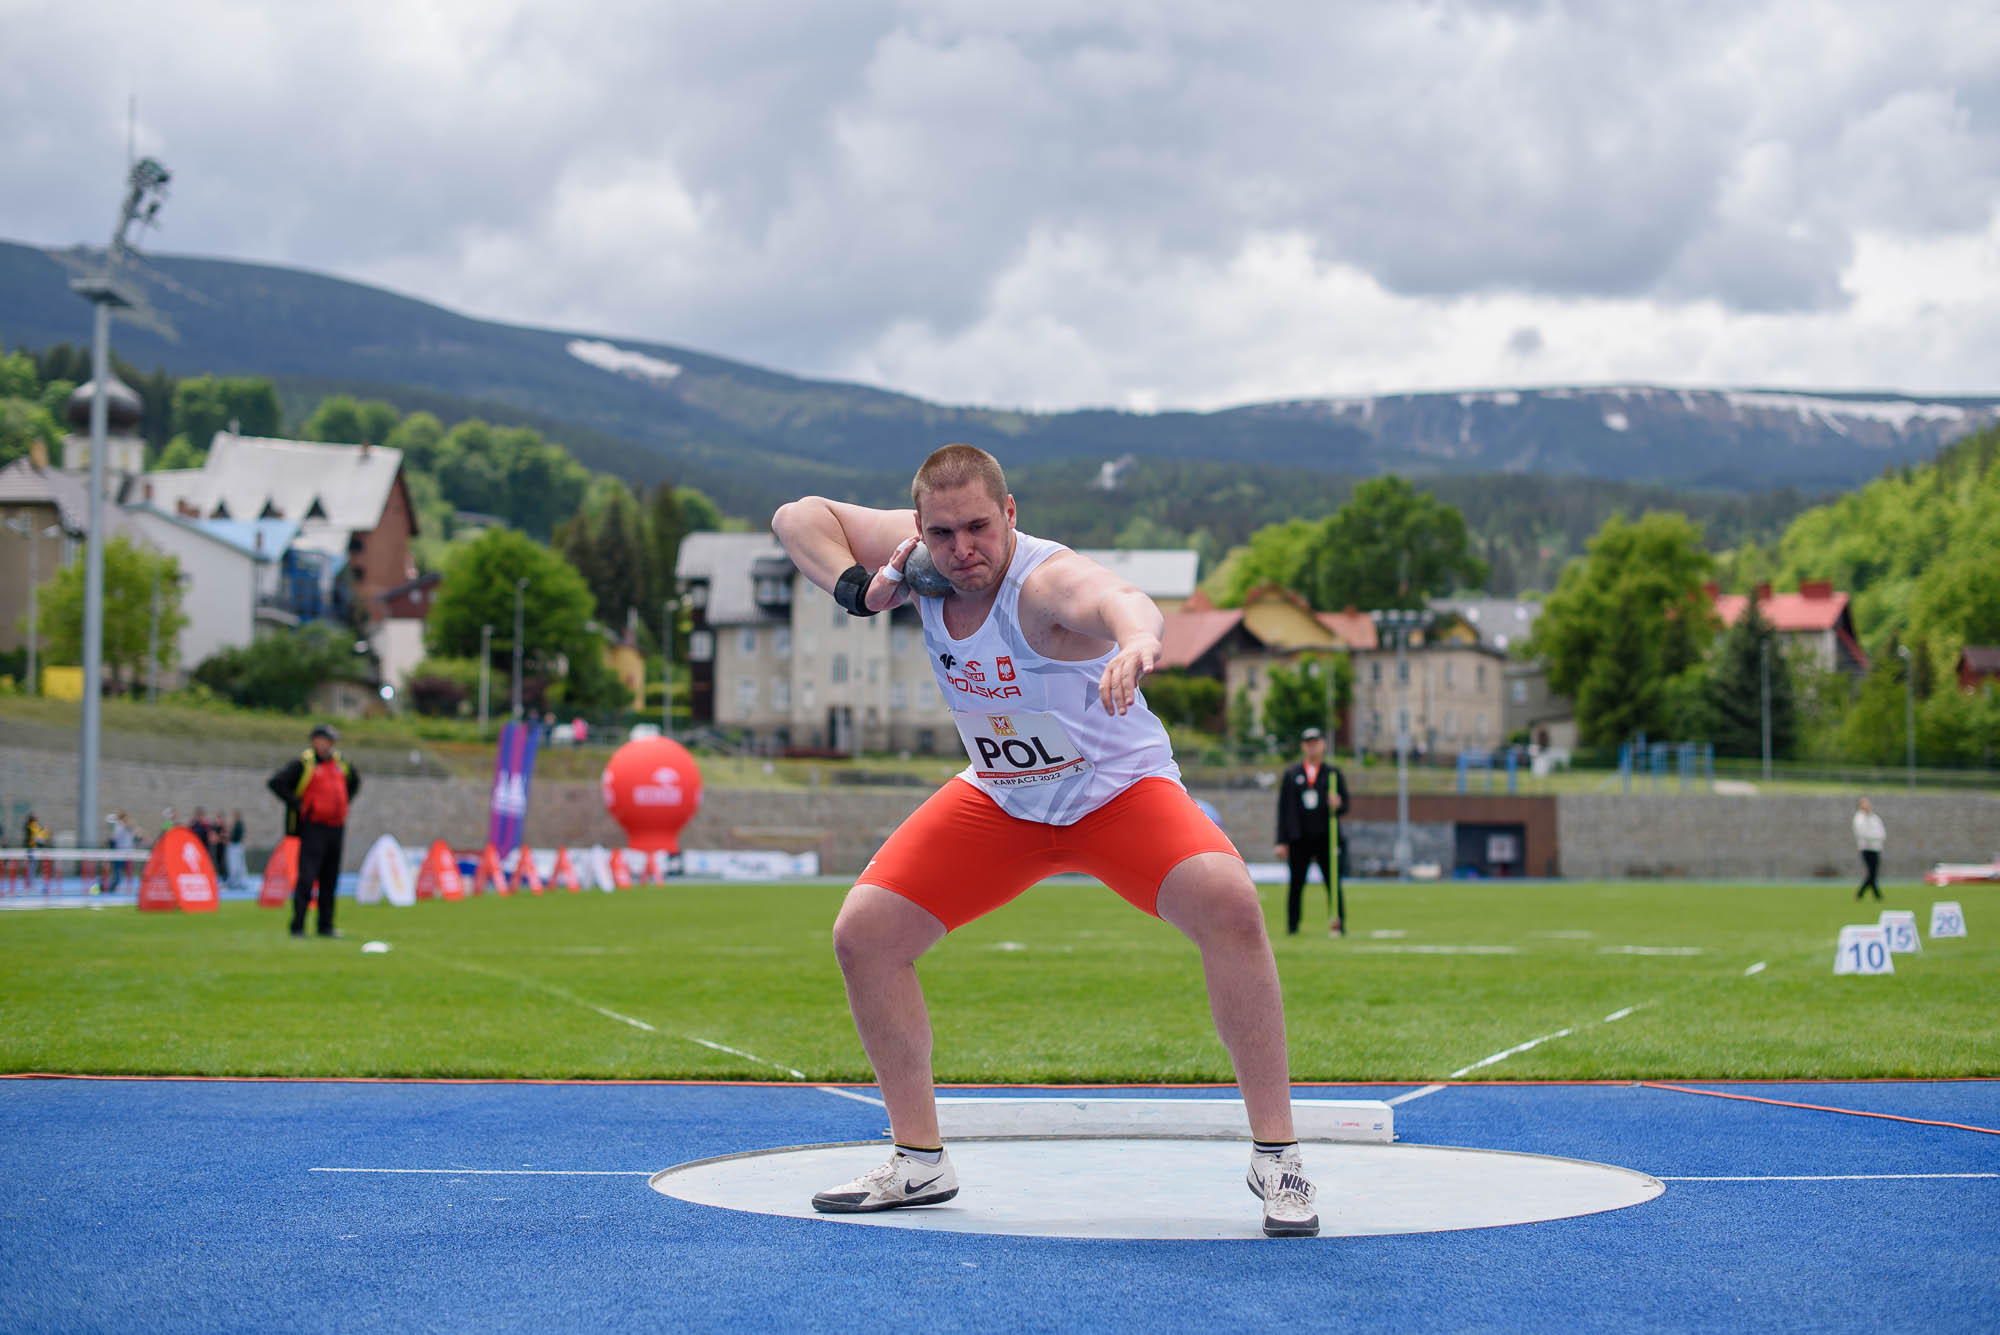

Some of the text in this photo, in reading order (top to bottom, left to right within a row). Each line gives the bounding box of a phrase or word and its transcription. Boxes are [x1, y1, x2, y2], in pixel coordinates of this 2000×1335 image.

[946, 671, 1022, 699] POLSKA
[974, 736, 1065, 769] POL
[993, 776, 1038, 786] KARPACZ
[1039, 772, 1061, 782] 2022
[1935, 912, 1961, 934] 20
[1885, 926, 1912, 949] 15
[1849, 941, 1885, 970] 10
[1279, 1172, 1311, 1197] NIKE
